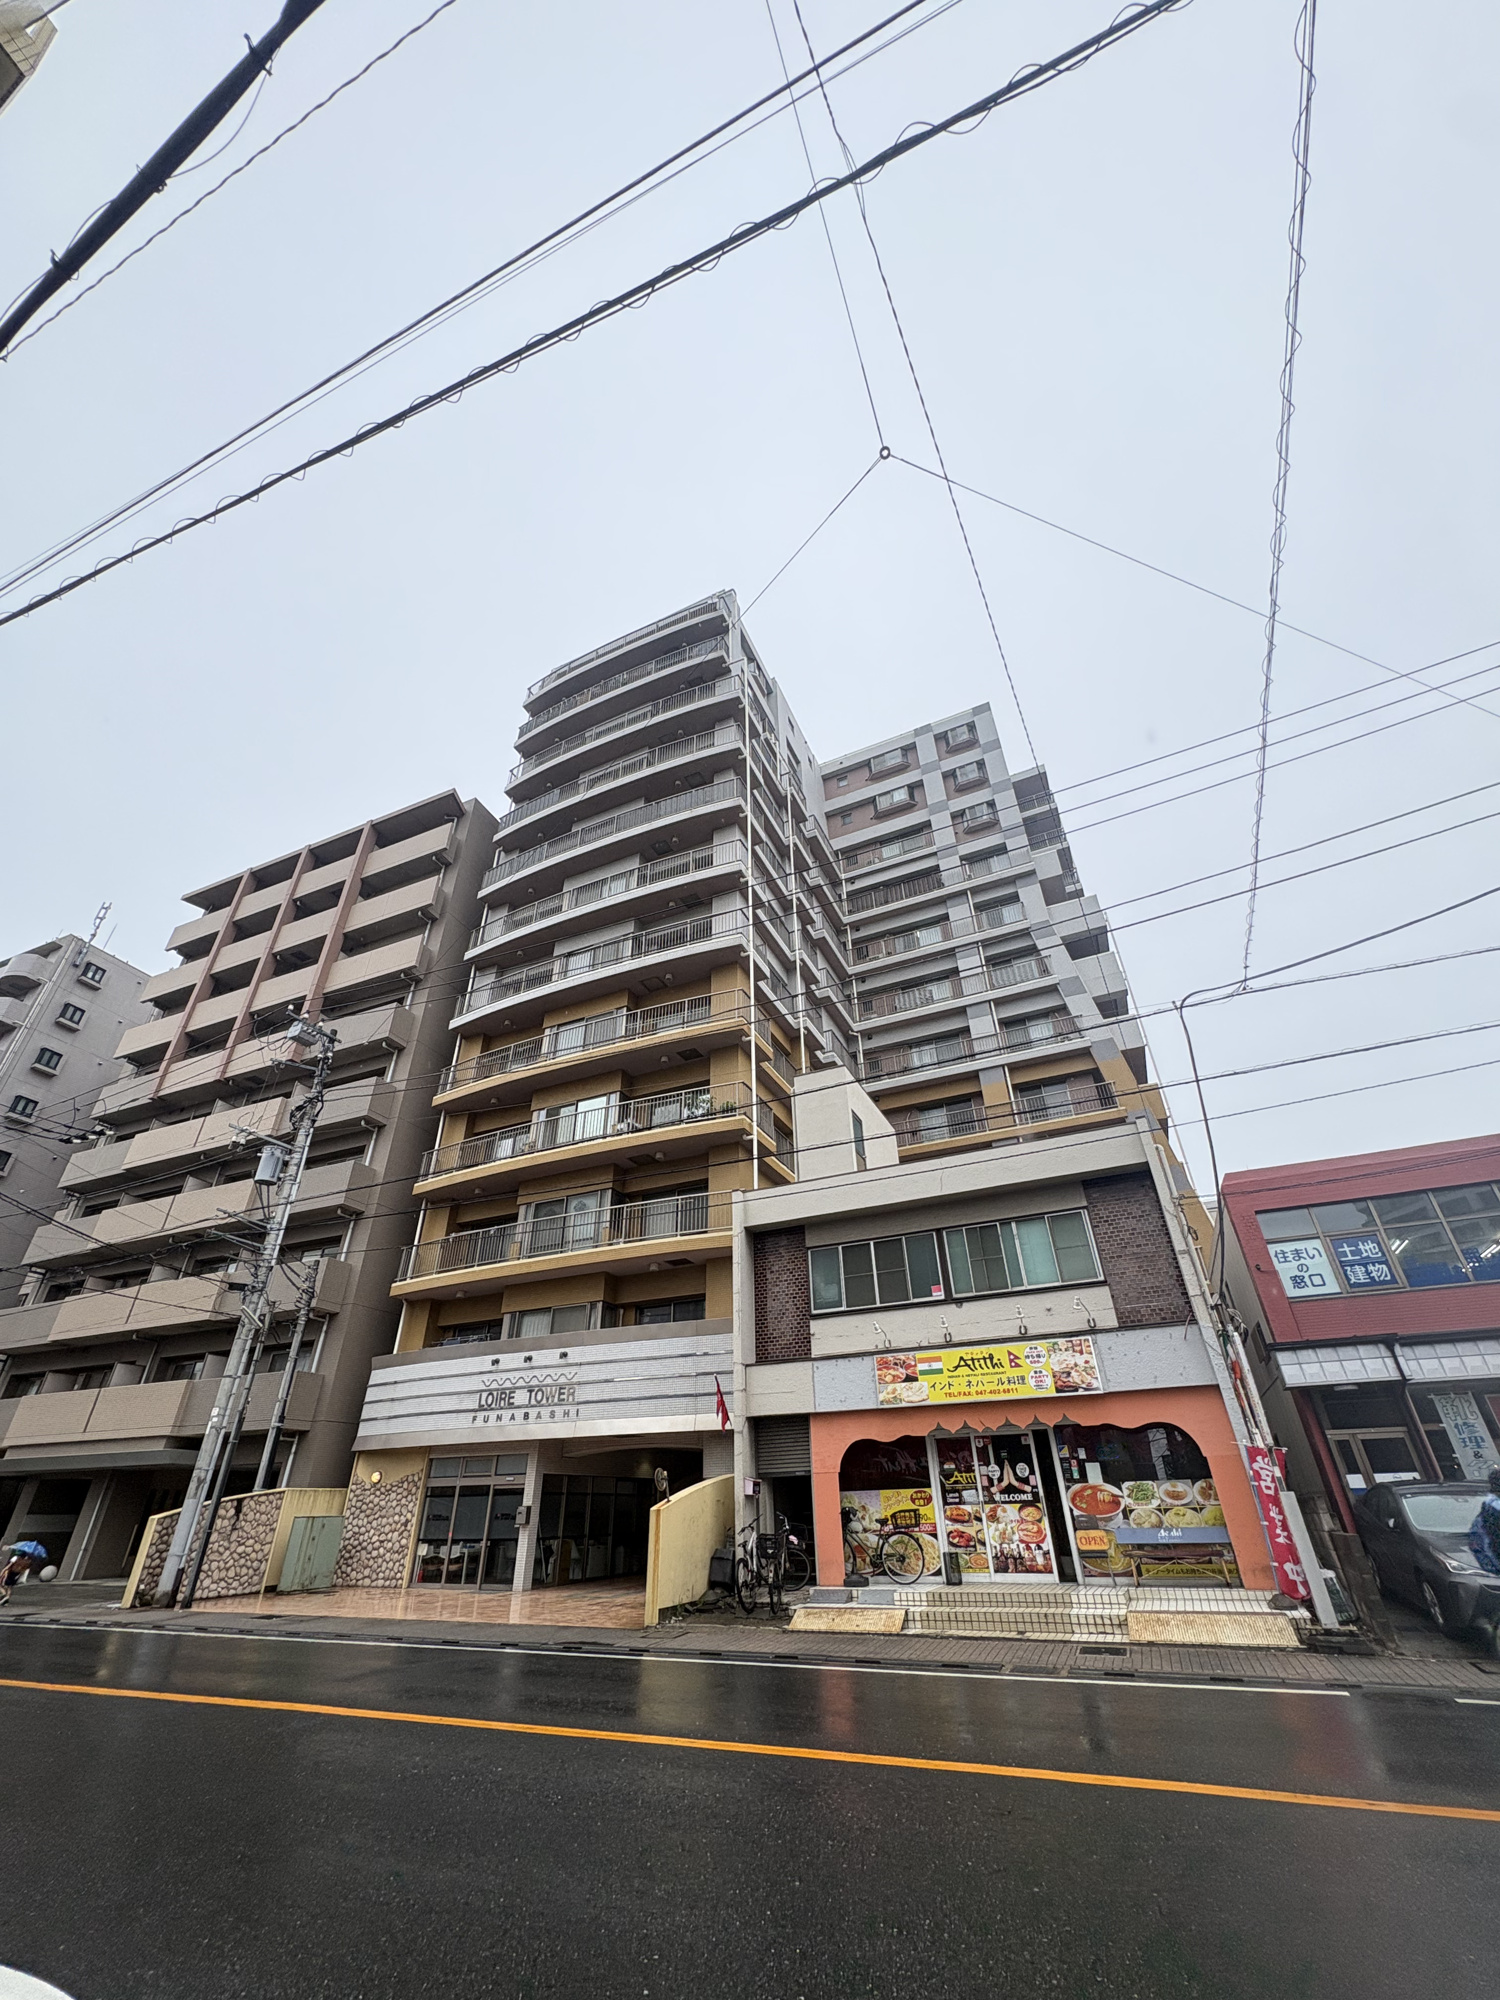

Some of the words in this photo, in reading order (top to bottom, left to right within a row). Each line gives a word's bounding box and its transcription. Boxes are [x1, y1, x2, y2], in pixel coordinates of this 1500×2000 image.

[1273, 1246, 1323, 1265] 住まい
[1337, 1240, 1382, 1262] 土地
[1296, 1262, 1310, 1274] の
[1344, 1262, 1392, 1285] 建物
[1289, 1273, 1327, 1290] 窓口
[946, 1353, 1005, 1373] Atithi
[930, 1374, 1027, 1391] インド・ネパール料理
[478, 1390, 516, 1409] LOIRE
[526, 1386, 577, 1407] TOWER
[471, 1408, 580, 1425] FUNABASHI
[993, 1493, 1033, 1501] WELCOME
[1079, 1536, 1106, 1547] OPEN
